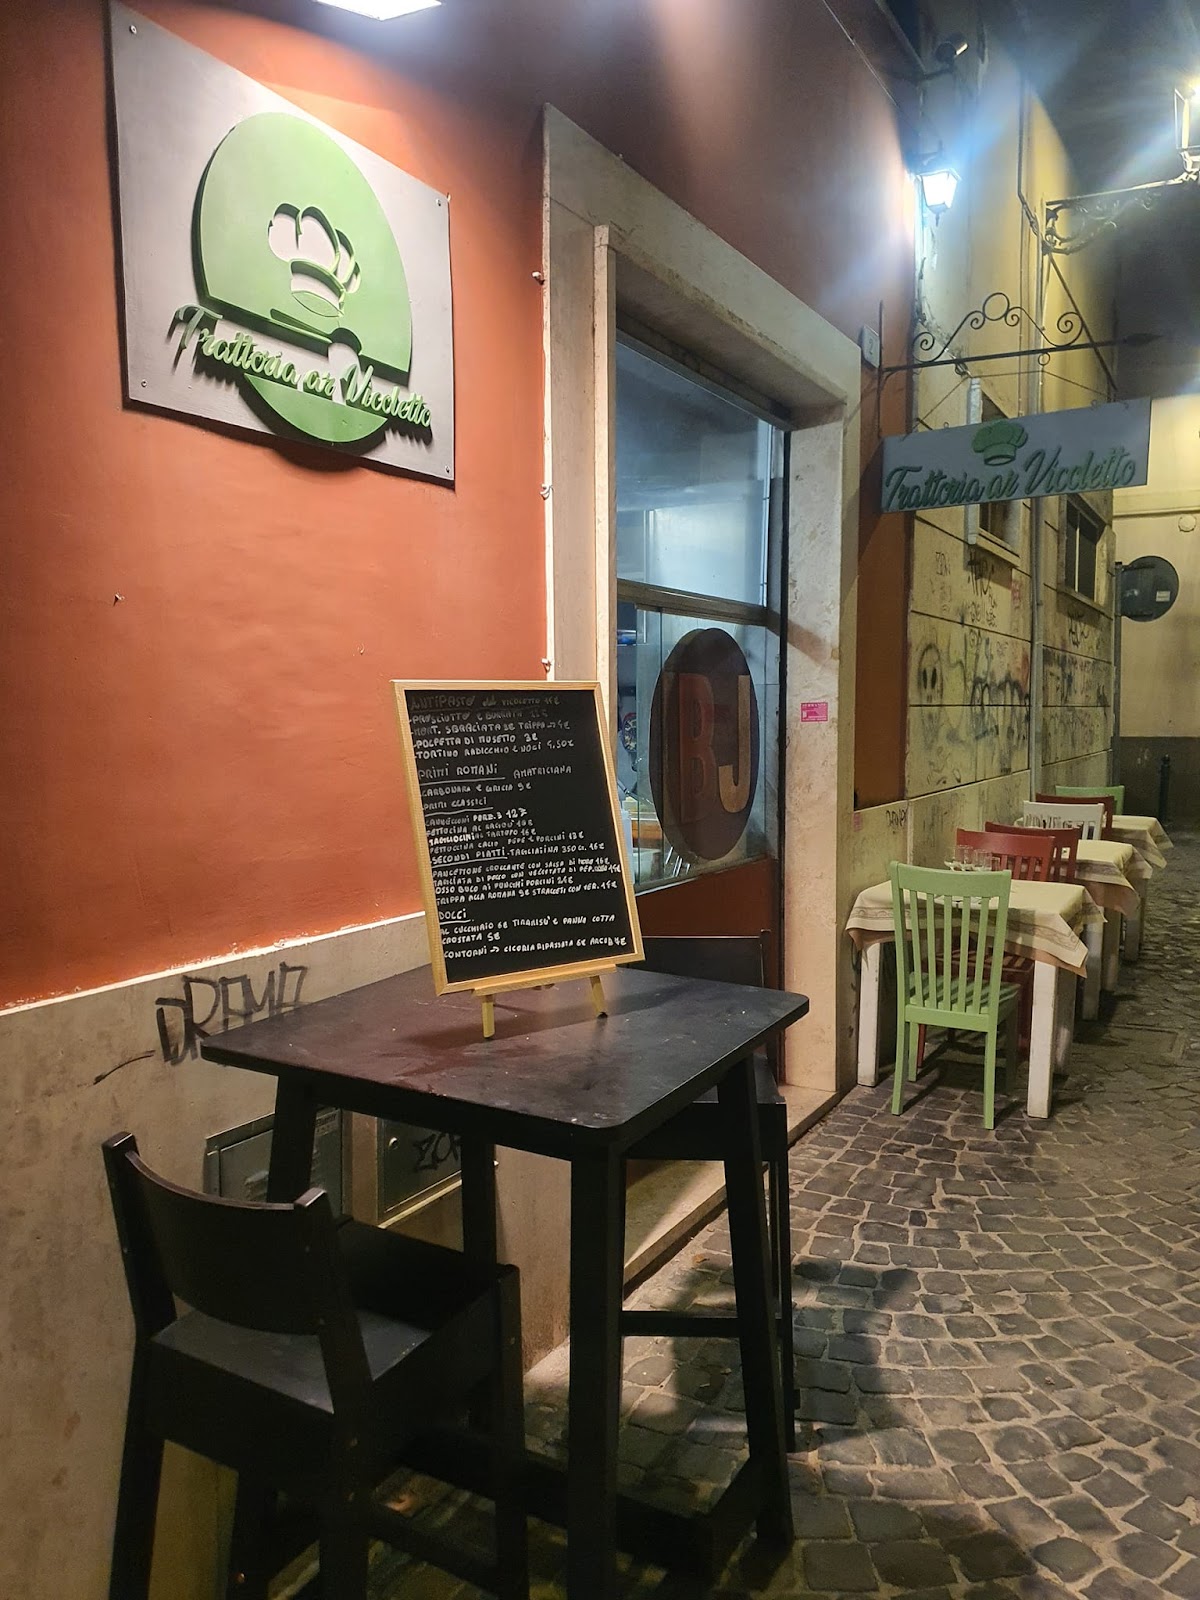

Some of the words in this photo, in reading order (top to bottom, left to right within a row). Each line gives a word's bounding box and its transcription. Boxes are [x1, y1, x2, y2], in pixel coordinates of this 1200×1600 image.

[177, 303, 302, 385] Trattoria
[305, 370, 335, 396] ar
[342, 364, 431, 428] Vicoletto
[885, 465, 985, 512] Trattoria
[986, 470, 1019, 499] ar
[1023, 444, 1136, 495] Vicoletto
[464, 747, 509, 756] RADICCHIO
[514, 765, 572, 779] AMATRICIANA
[422, 786, 471, 797] CARBONARA
[435, 886, 455, 894] OSSO
[488, 890, 515, 898] ROMANA
[443, 933, 482, 945] CROSTATA
